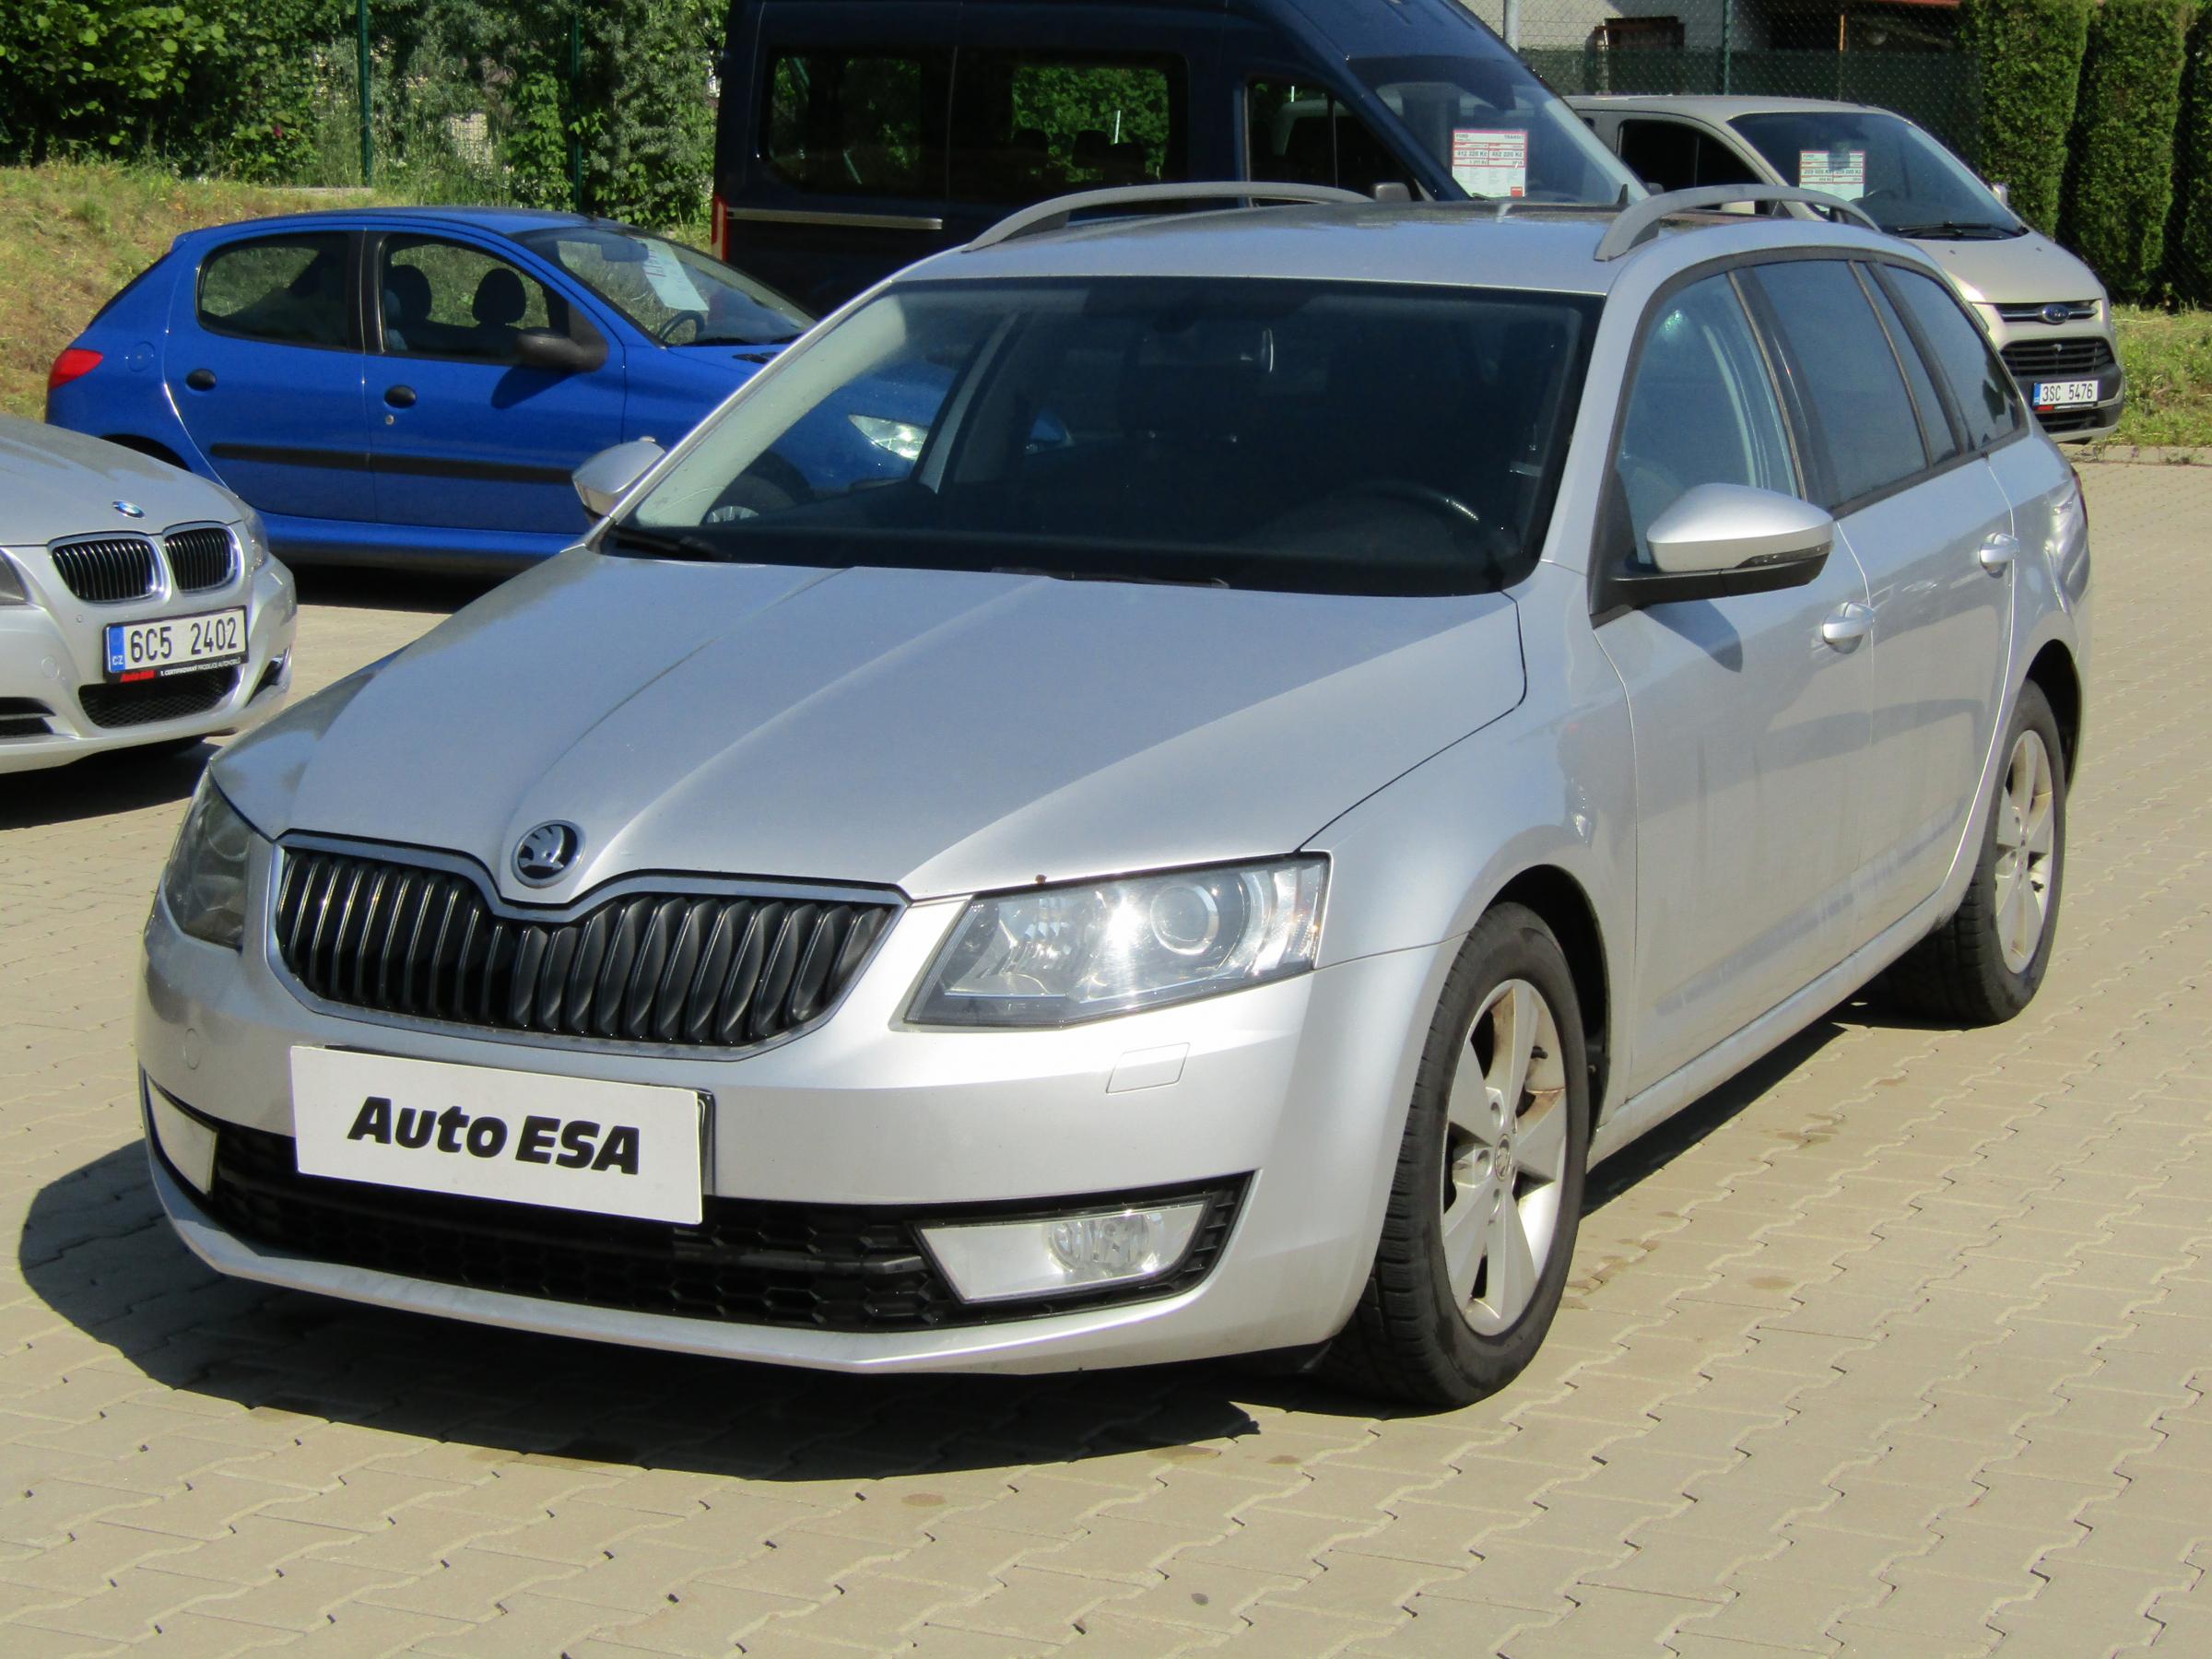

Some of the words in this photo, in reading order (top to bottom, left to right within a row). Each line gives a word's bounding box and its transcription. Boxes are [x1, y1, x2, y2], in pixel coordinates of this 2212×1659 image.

[2042, 385, 2061, 402] 3SC
[2068, 383, 2093, 400] 5476
[131, 626, 172, 663] 6C5
[190, 617, 237, 655] 2402
[112, 654, 124, 665] CZ
[347, 1096, 508, 1159] Auto
[515, 1115, 640, 1175] ESA
